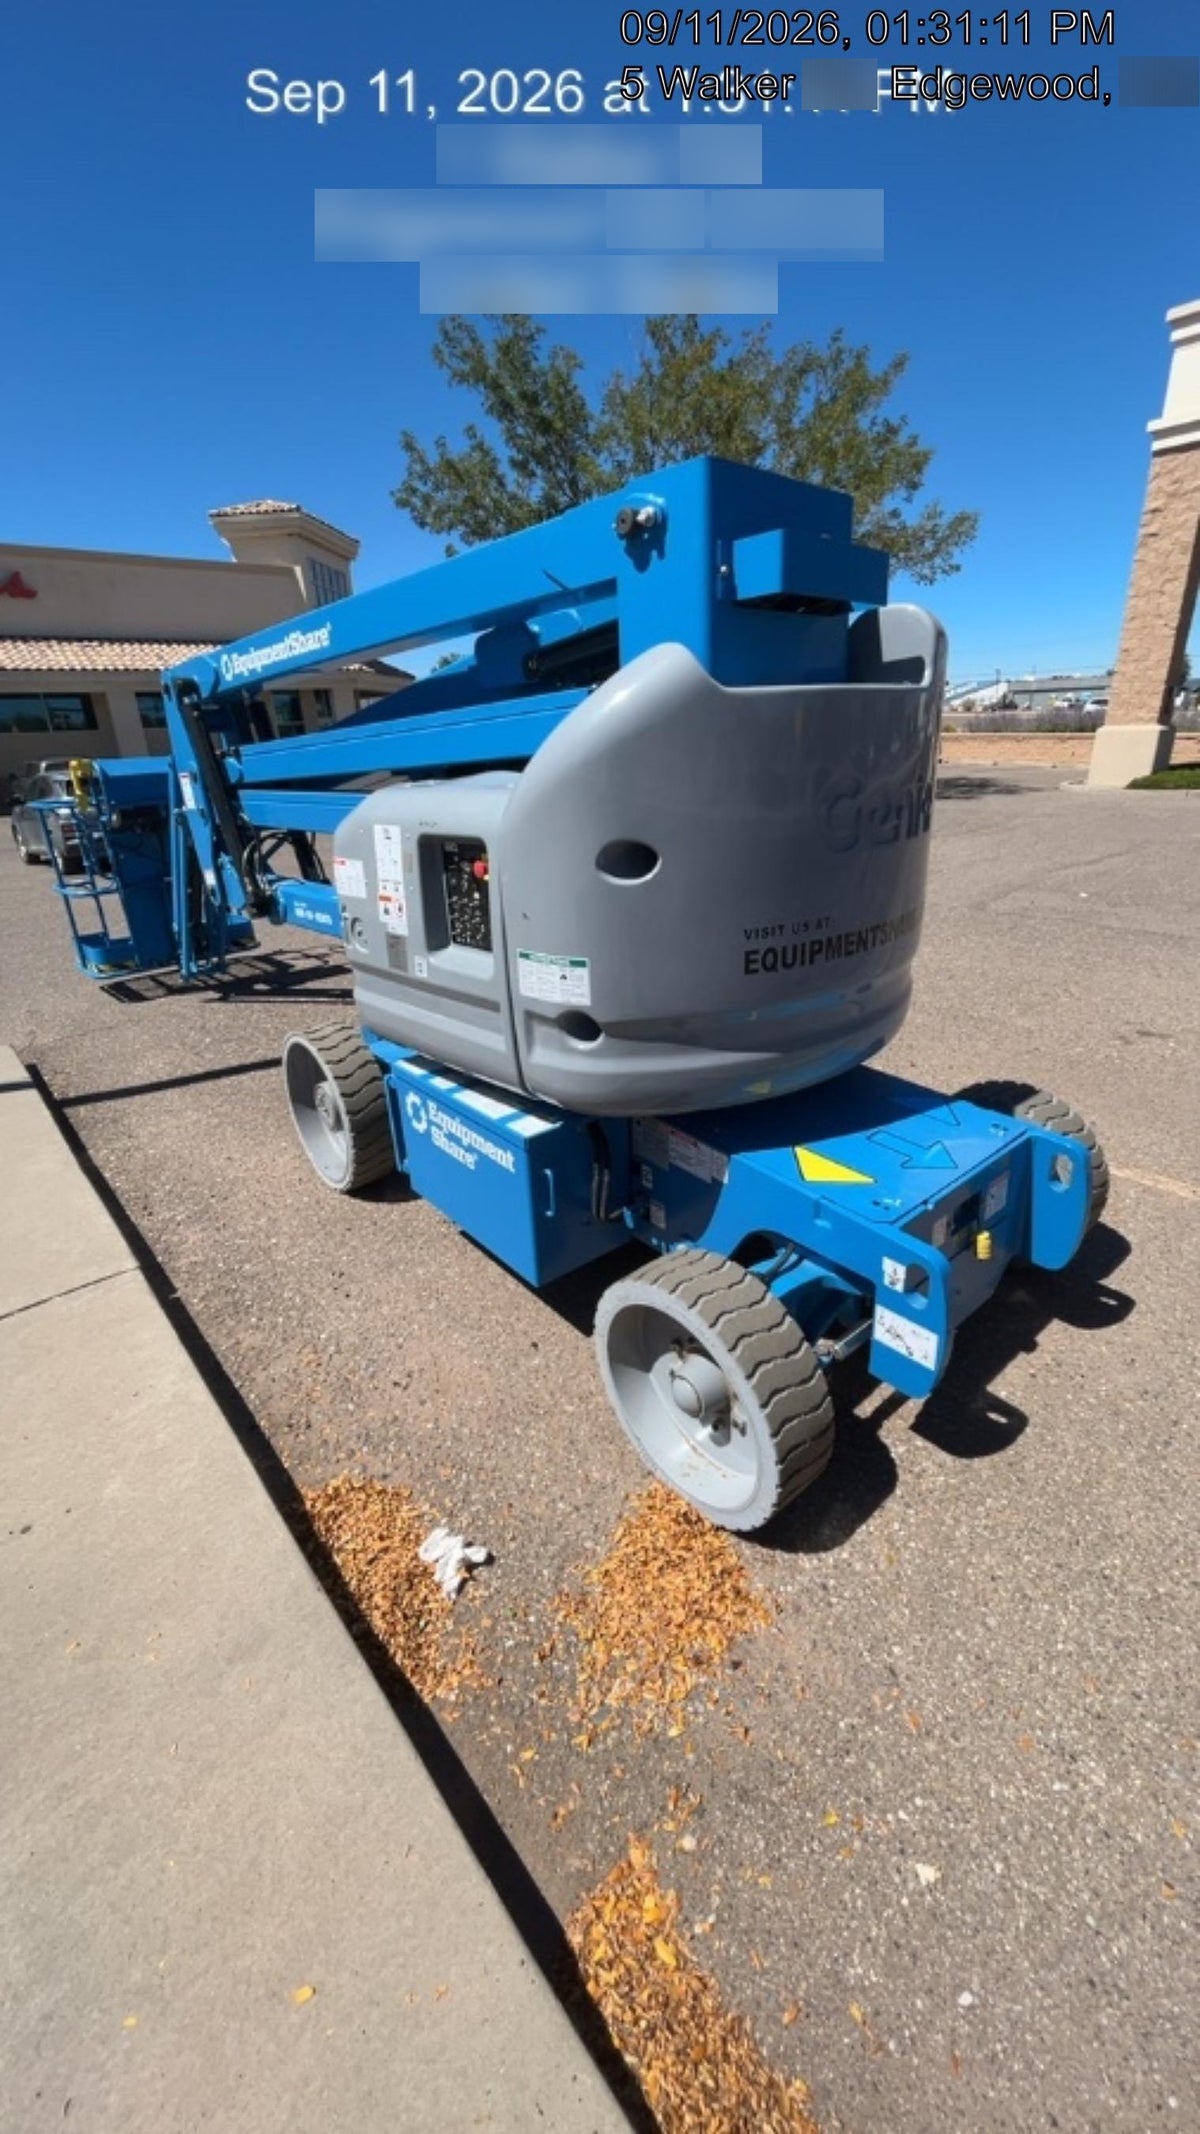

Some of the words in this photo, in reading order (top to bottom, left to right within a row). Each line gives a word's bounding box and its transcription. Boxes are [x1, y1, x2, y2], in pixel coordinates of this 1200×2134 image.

[744, 923, 786, 942] VISIT
[791, 919, 809, 935] US
[426, 1099, 516, 1174] Equipment
[430, 1125, 476, 1171] Share
